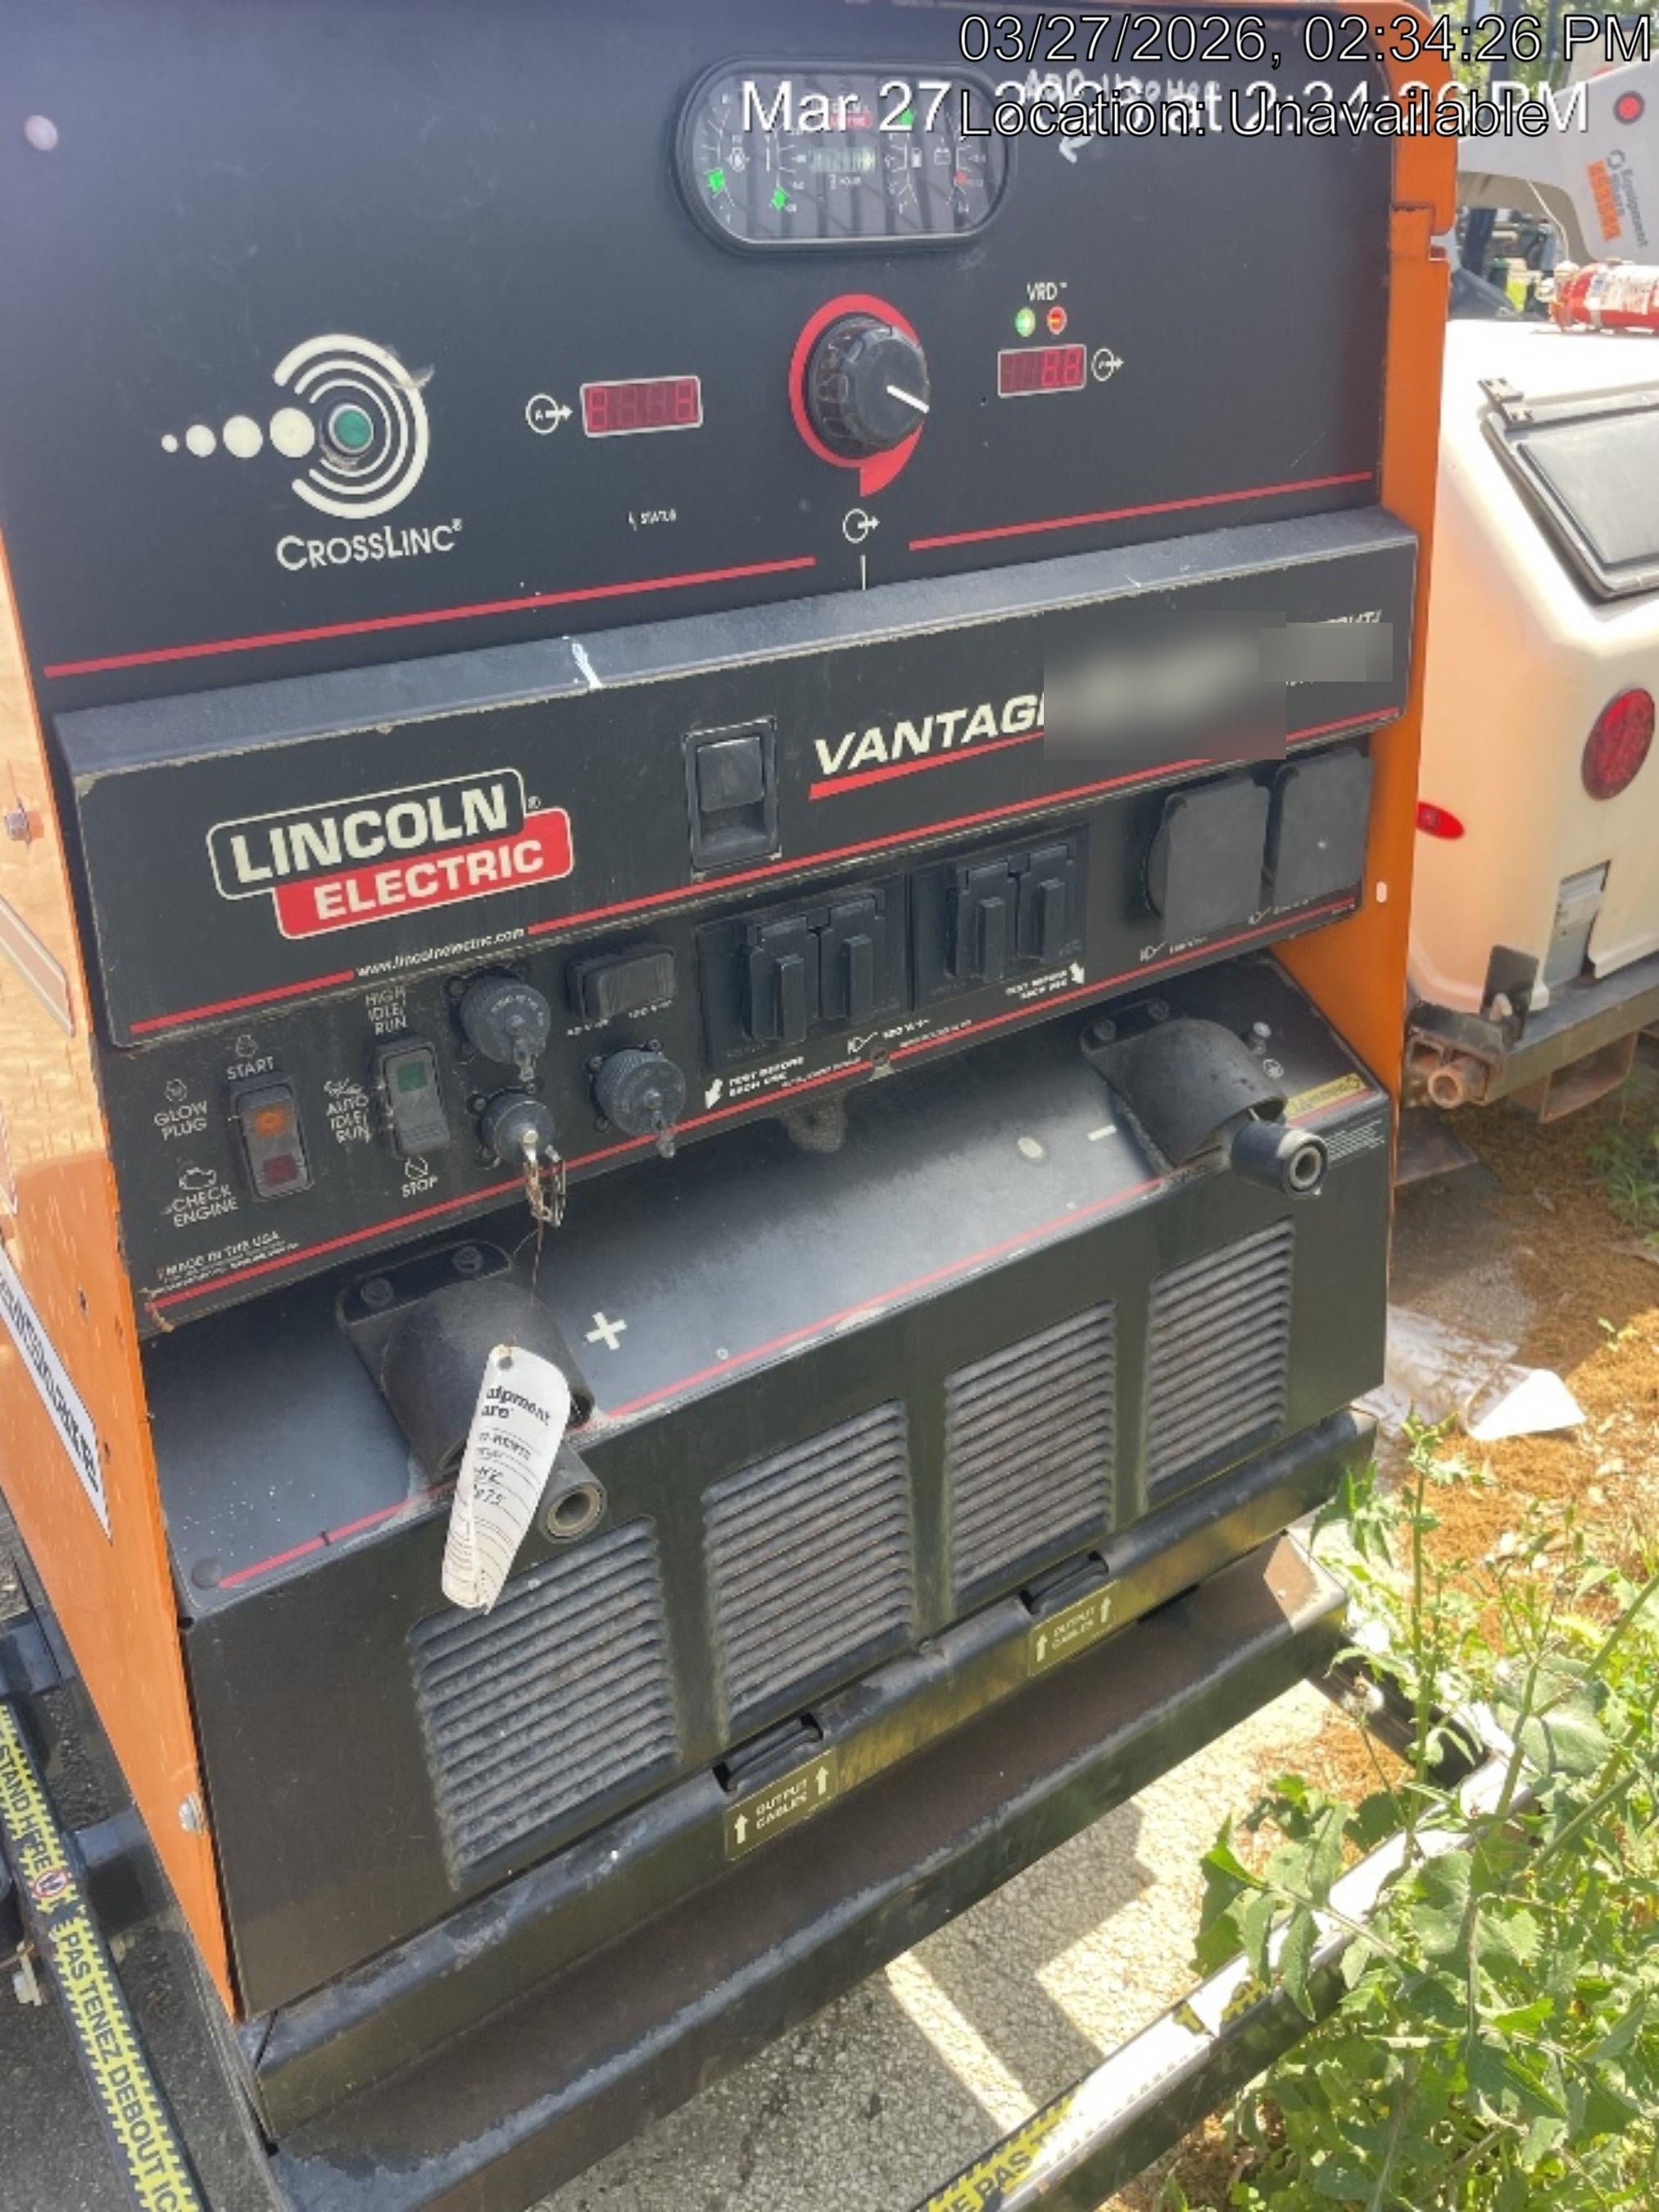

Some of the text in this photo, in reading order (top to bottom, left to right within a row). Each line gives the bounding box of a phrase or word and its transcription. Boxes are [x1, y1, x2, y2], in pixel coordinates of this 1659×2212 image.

[814, 690, 1045, 777] VANTAG
[230, 782, 510, 884] LINCOLN
[313, 839, 545, 921] ELECTRIC
[357, 927, 525, 978] www.lincolnelectric.com
[365, 985, 407, 1008] HIGH
[374, 1015, 408, 1036] RUN
[227, 1055, 274, 1081] START
[154, 1101, 208, 1126] GLOW
[326, 1094, 369, 1117] AUTO
[161, 1117, 207, 1142] PLUG
[336, 1125, 371, 1144] RUN
[170, 1184, 233, 1213] CHECK
[401, 1176, 438, 1198] STOP
[173, 1197, 239, 1227] ENGINE
[66, 1930, 91, 1980] PAS
[79, 1981, 123, 2065] TENEZ
[107, 2065, 167, 2178] DEBOUT
